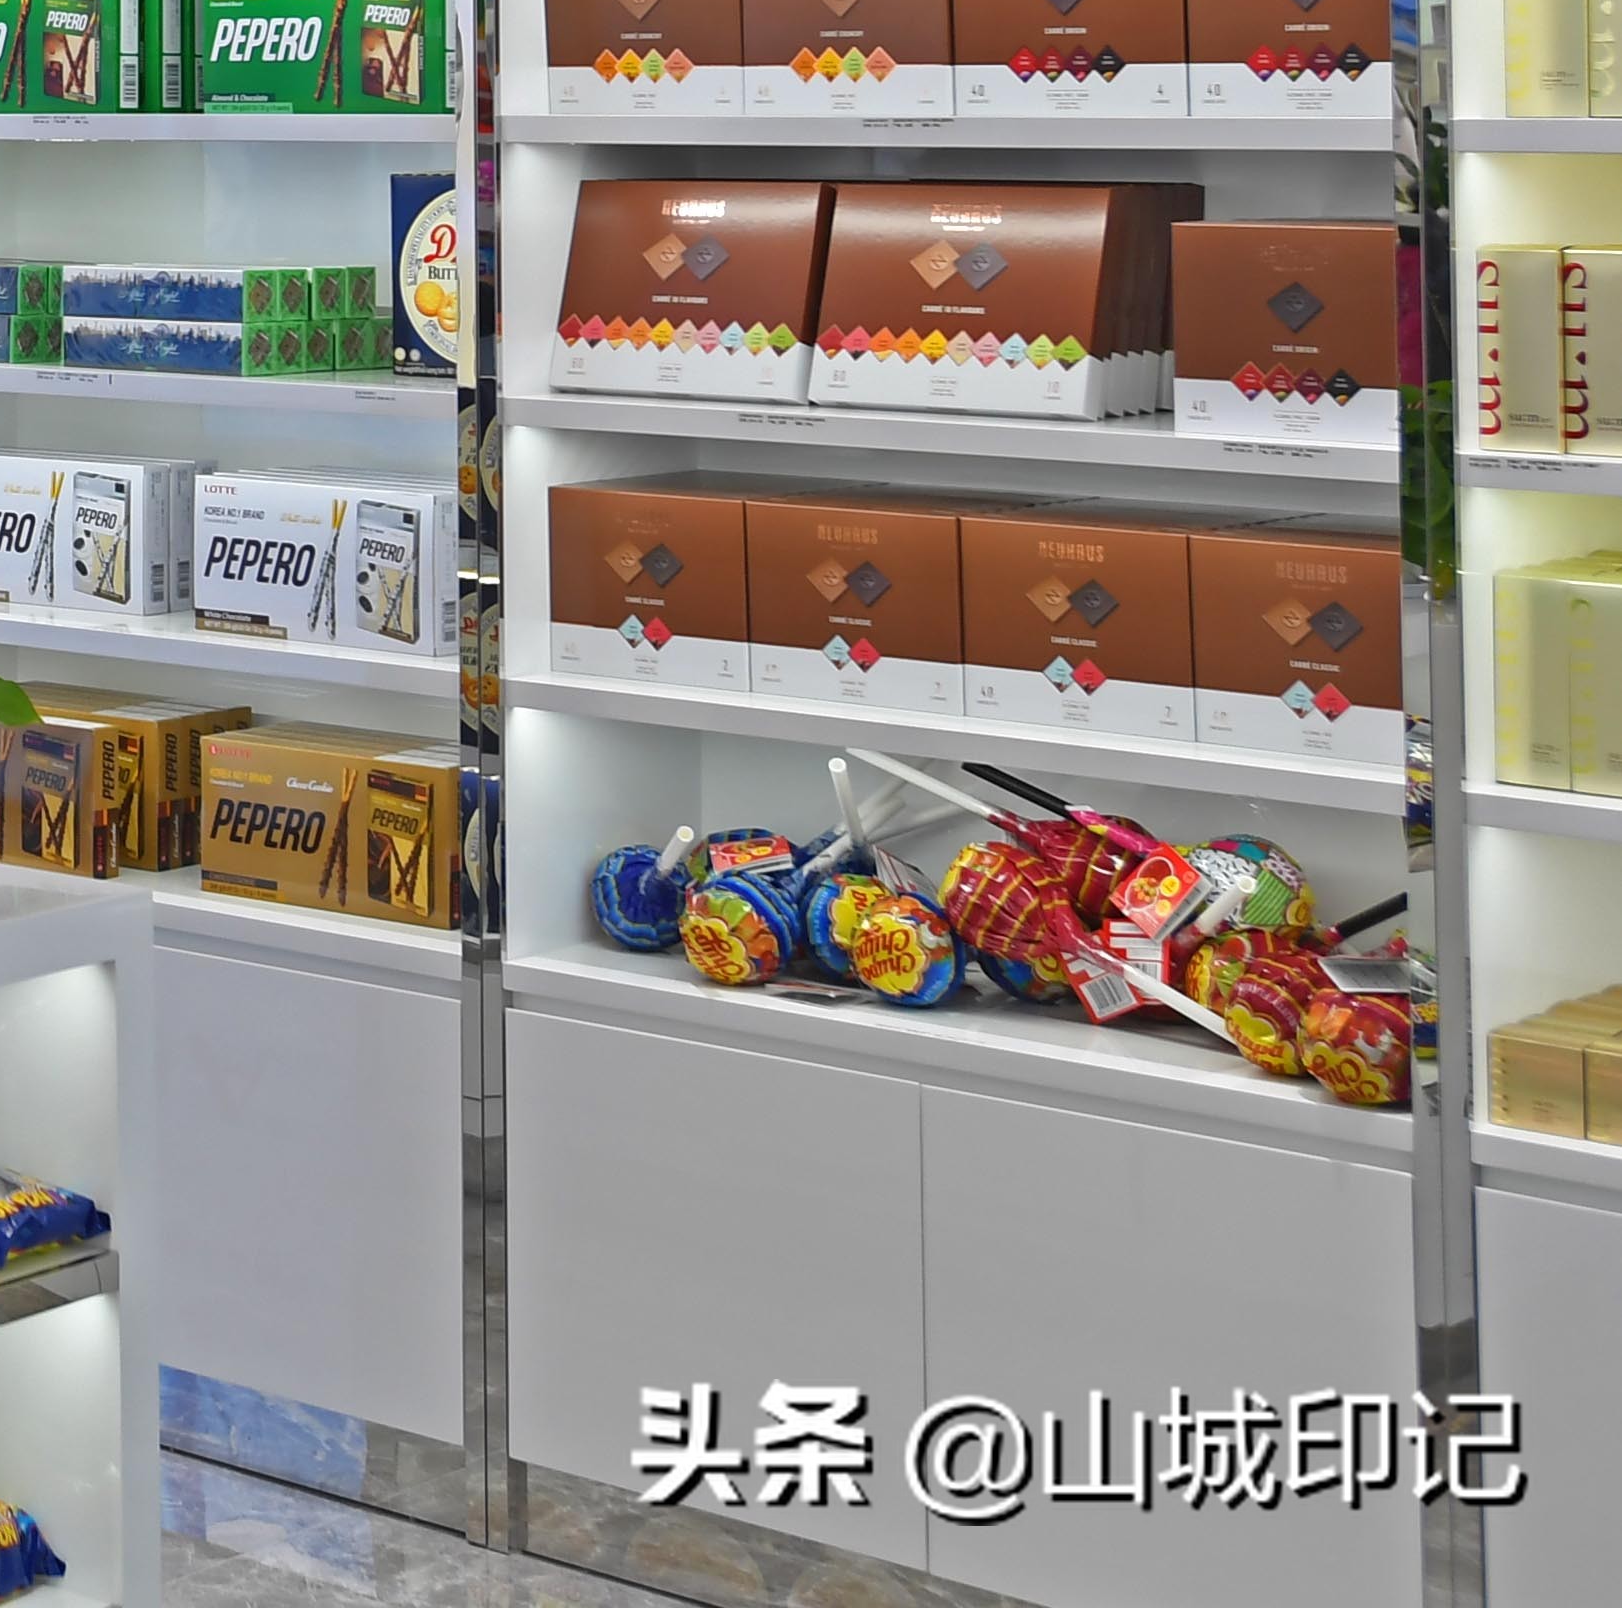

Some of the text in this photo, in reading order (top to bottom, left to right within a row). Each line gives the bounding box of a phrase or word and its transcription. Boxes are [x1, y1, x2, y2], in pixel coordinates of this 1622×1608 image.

[45, 10, 89, 31] PEPERO
[364, 4, 411, 27] PEPERO
[209, 16, 323, 62] PEPERO
[204, 484, 237, 495] LOTTE
[76, 506, 118, 530] PEPERO
[204, 506, 226, 518] KOREA
[241, 508, 265, 520] BRAND
[204, 535, 316, 587] PEPERO
[359, 538, 406, 563] PEPERO
[1038, 540, 1105, 563] NEUHAUS
[1275, 559, 1348, 584] NEUHAUS
[102, 740, 115, 800] PEPERO
[165, 733, 177, 792] PEPERO
[26, 767, 67, 792] PEPERO
[210, 798, 326, 854] PEPERO
[371, 808, 419, 836] PEPERO
